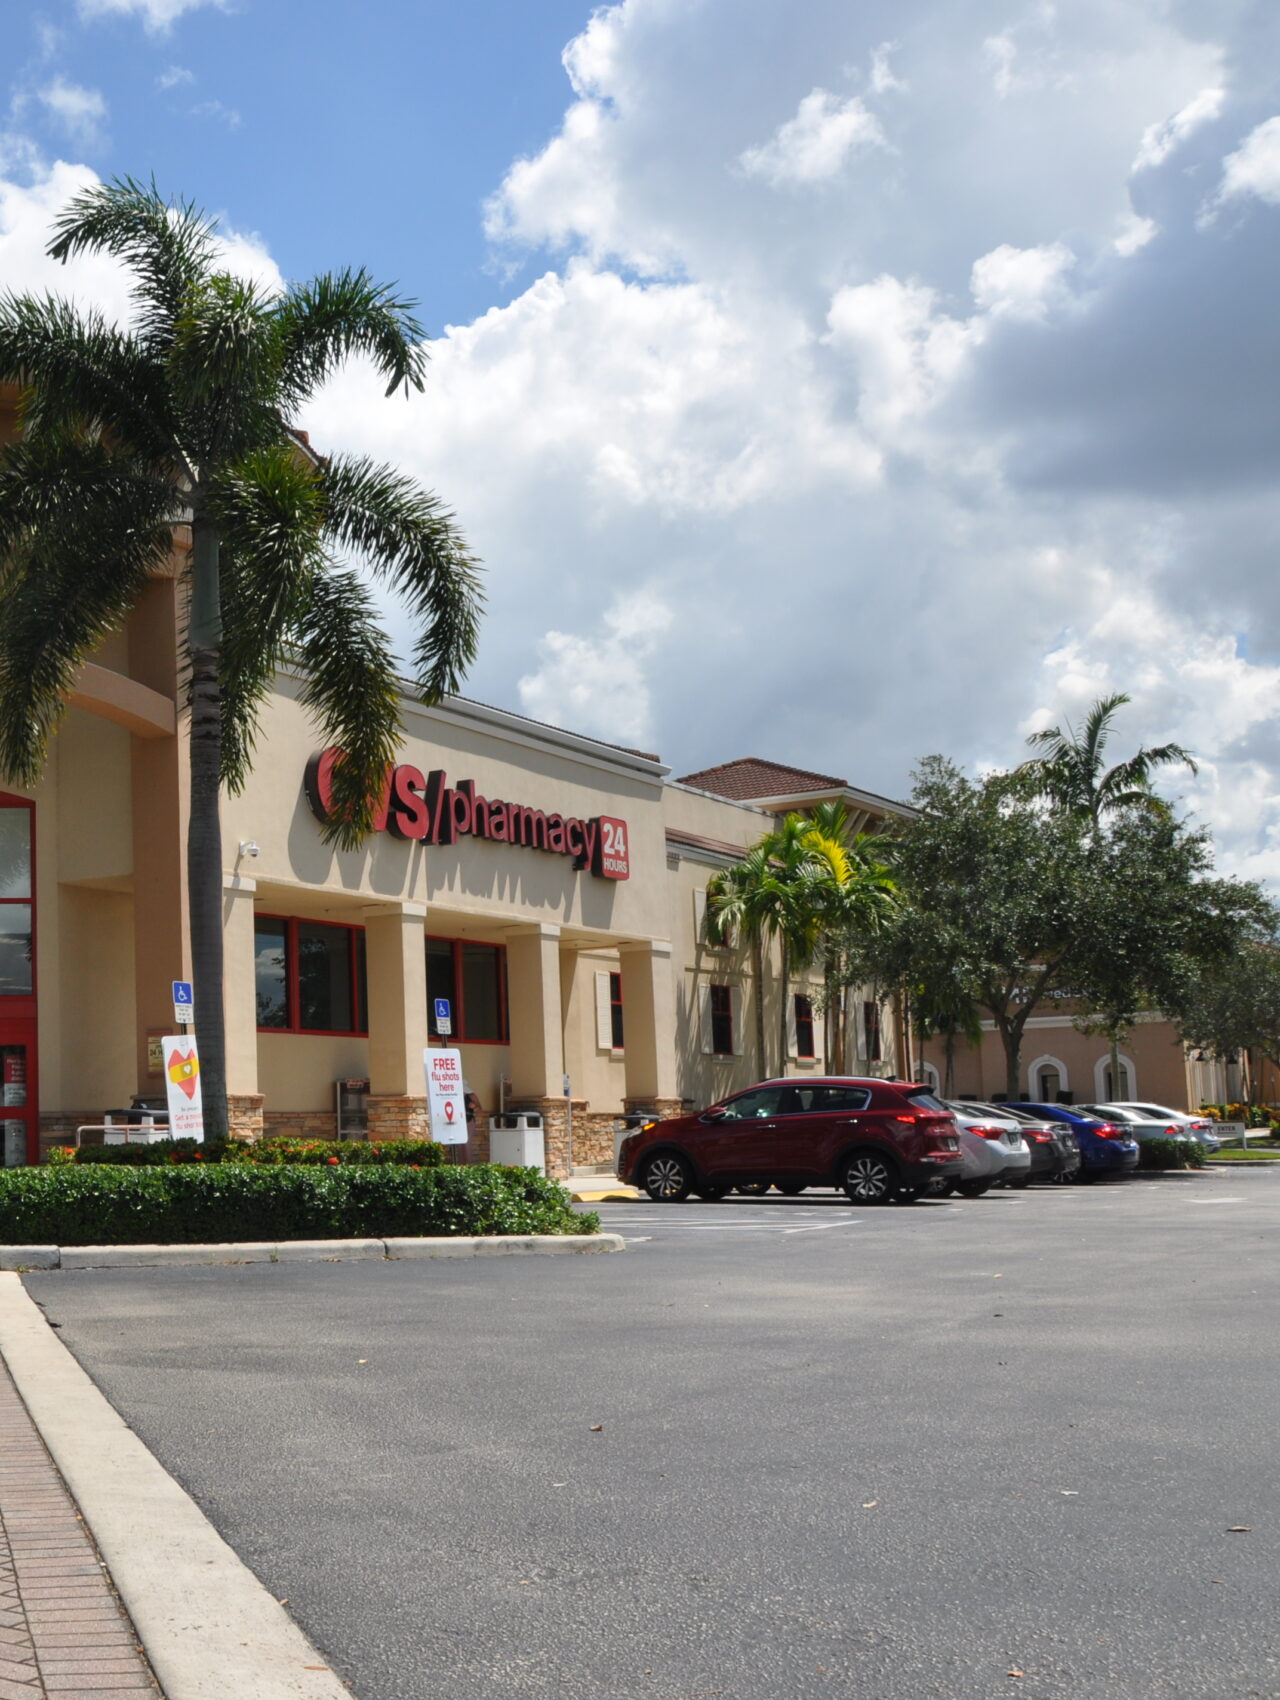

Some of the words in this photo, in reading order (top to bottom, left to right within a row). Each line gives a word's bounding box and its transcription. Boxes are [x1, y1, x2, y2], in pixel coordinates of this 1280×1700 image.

[603, 823, 626, 857] 24
[603, 857, 628, 874] HOURS
[433, 1058, 456, 1071] FREE
[431, 1071, 441, 1082] flu
[441, 1072, 460, 1081] shots
[439, 1082, 455, 1092] here
